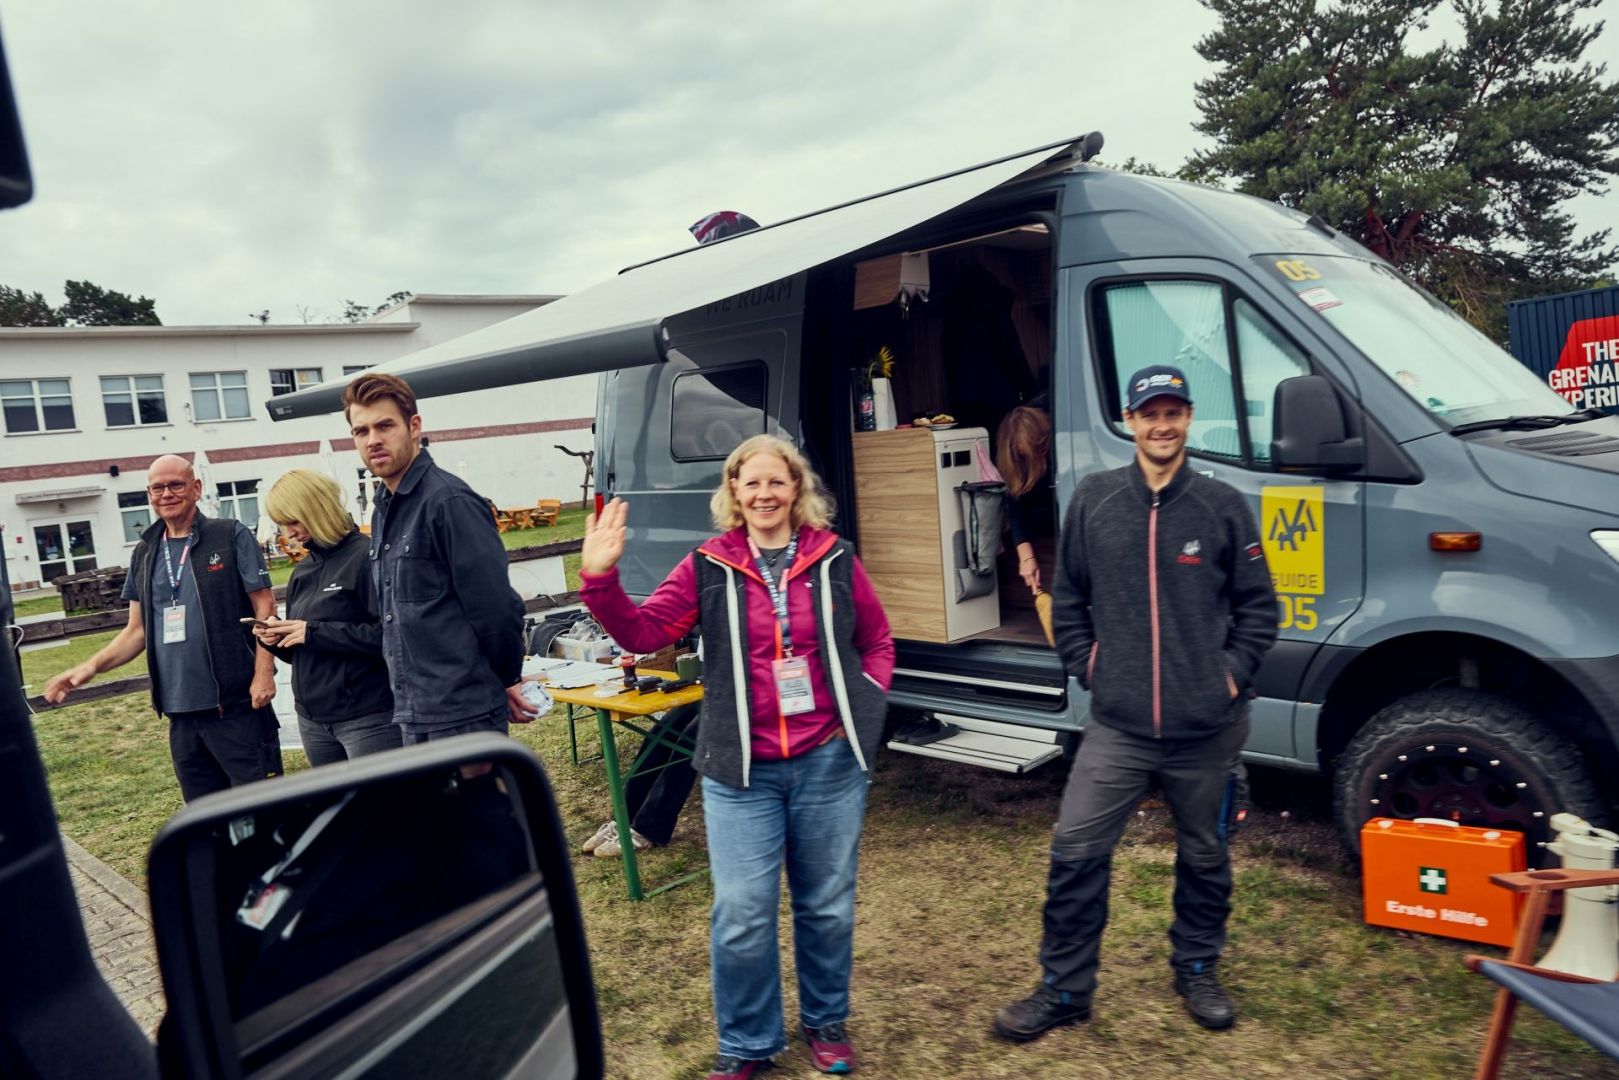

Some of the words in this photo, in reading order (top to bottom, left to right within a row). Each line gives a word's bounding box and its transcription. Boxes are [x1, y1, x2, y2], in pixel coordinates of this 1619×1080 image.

[1275, 259, 1322, 281] 05
[738, 279, 793, 308] ROAM
[1581, 339, 1619, 363] THE
[1270, 573, 1318, 588] GUIDE
[1386, 900, 1436, 918] Erste
[1440, 908, 1488, 926] Hilfe
